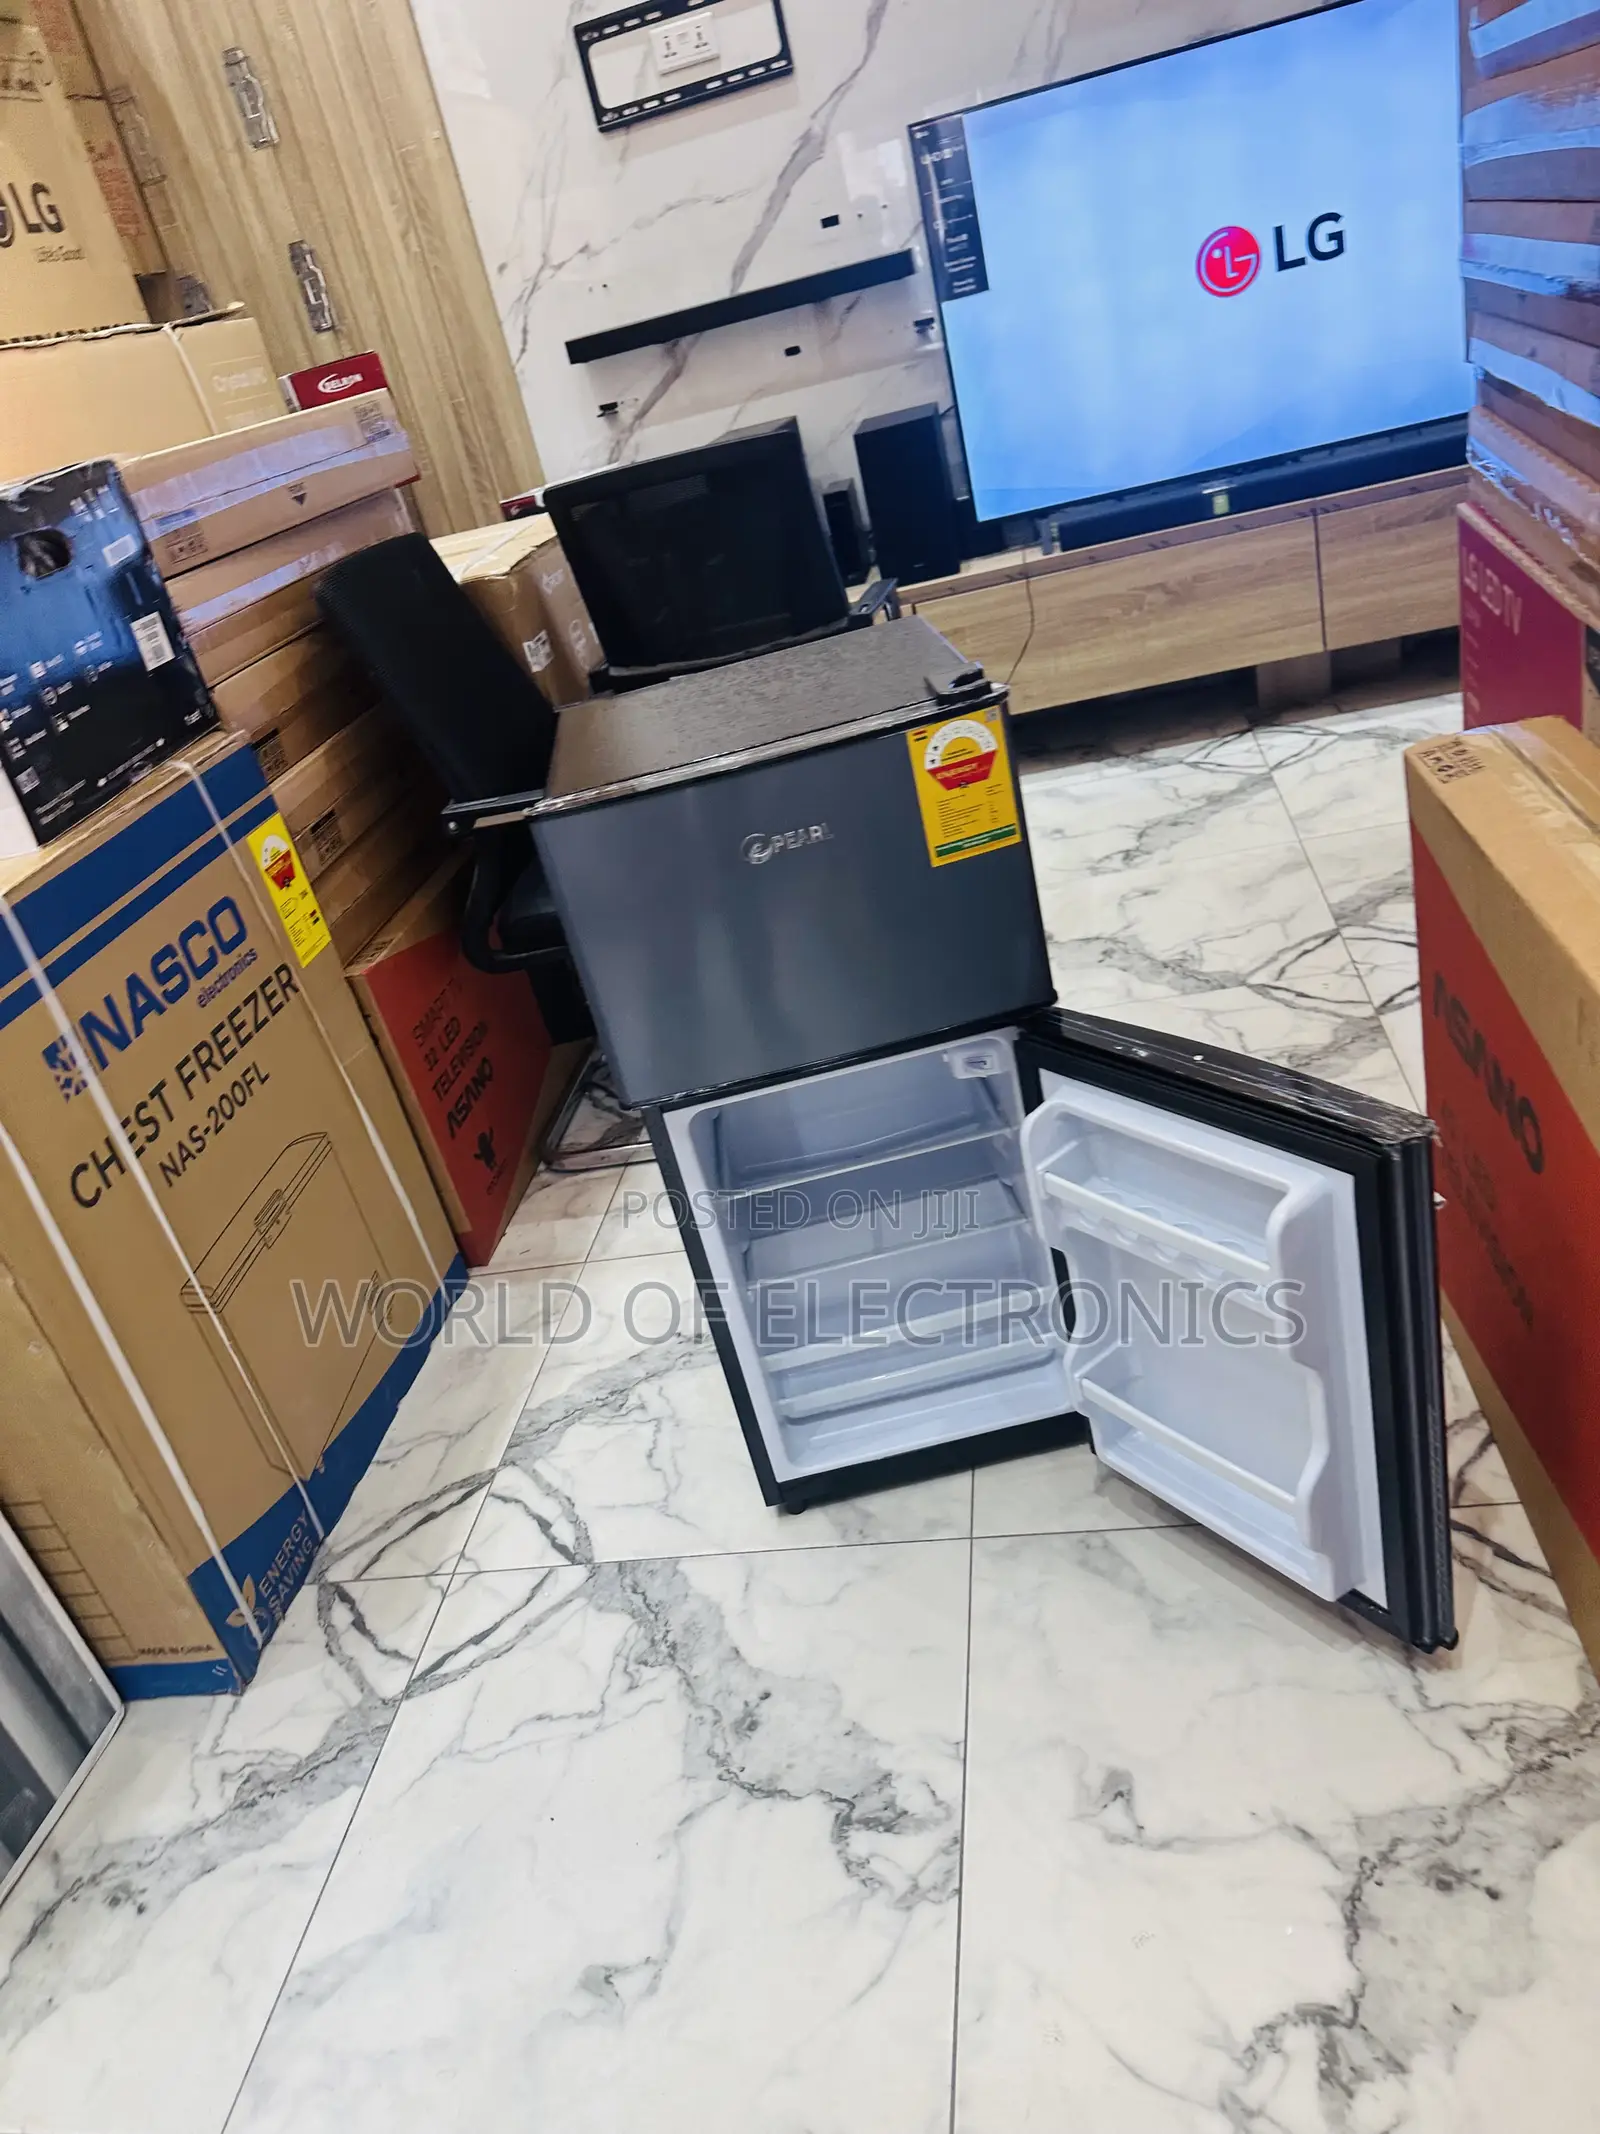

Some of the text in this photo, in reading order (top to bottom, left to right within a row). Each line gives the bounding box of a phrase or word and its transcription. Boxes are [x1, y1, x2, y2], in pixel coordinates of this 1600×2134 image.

[7, 182, 65, 233] LG
[1274, 212, 1346, 272] LG
[79, 896, 247, 1071] NASCO
[197, 948, 258, 1008] electronics
[70, 963, 300, 1209] CHEST FREEZER
[158, 1061, 270, 1187] NAS-200FL
[259, 1510, 309, 1597] ENERGY
[268, 1536, 314, 1611] SAVING
